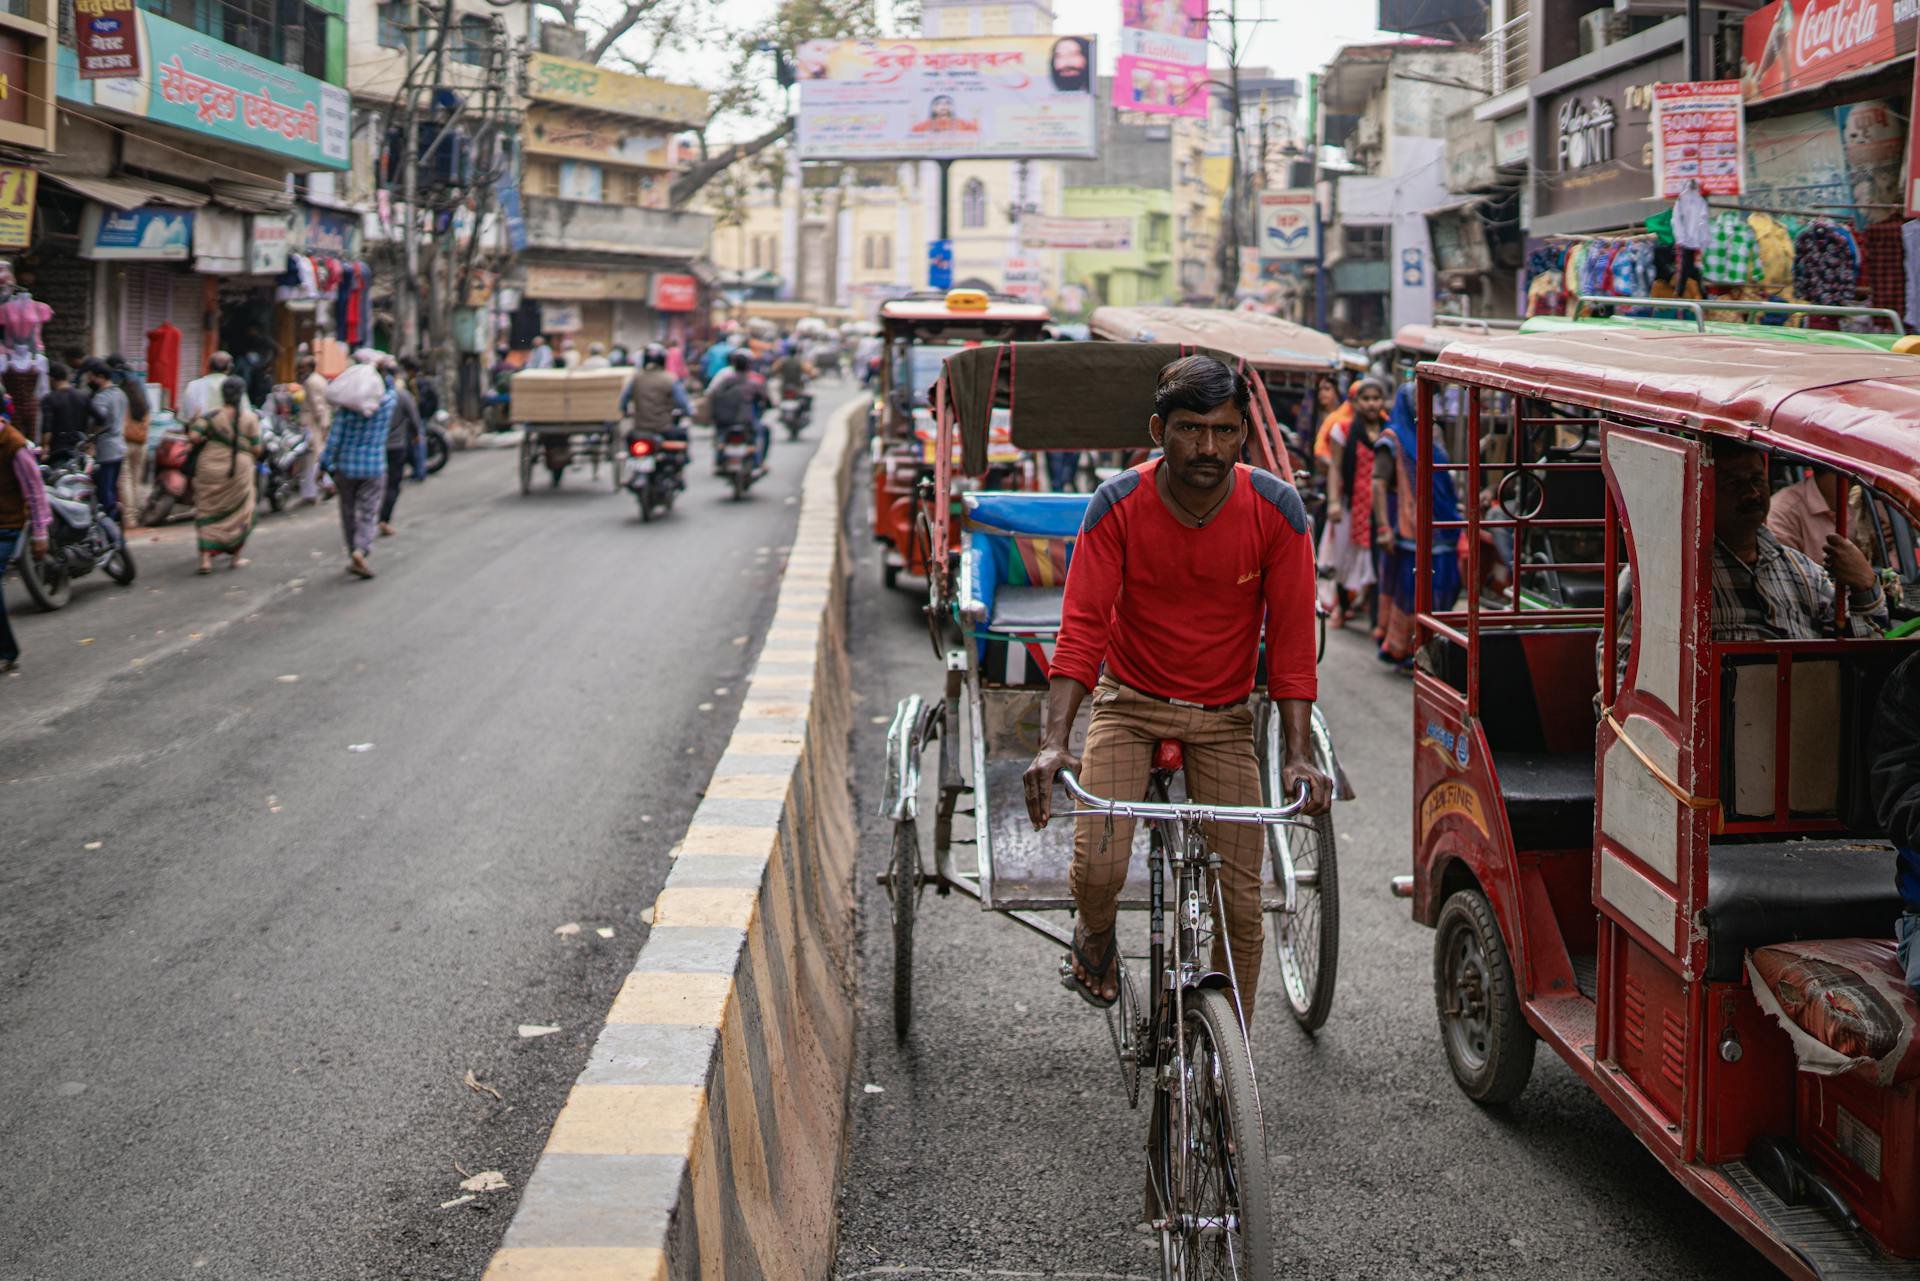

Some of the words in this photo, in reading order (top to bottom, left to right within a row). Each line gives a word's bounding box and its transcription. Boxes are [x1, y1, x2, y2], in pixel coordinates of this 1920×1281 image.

[158, 54, 237, 125] सेन्ट्रल
[242, 87, 320, 143] एकेडमी
[1557, 121, 1615, 174] POINT
